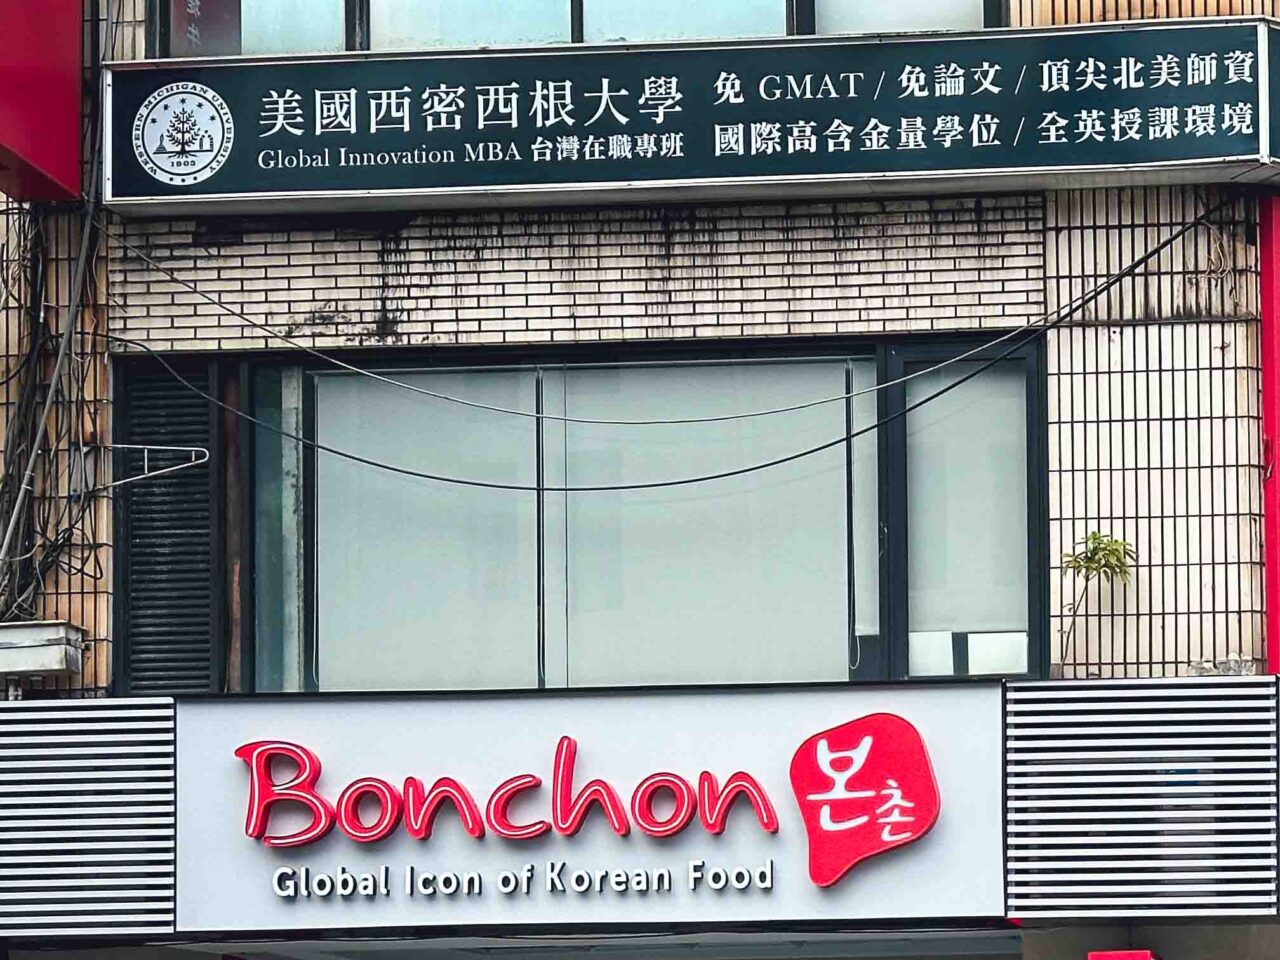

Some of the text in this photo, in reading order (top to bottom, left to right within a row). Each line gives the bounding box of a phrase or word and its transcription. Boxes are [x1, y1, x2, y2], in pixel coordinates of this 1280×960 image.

[144, 83, 208, 112] MICHIGAN
[712, 72, 745, 106] 免
[759, 71, 865, 101] GMAT
[897, 63, 1003, 99] 免論文
[1038, 49, 1255, 92] 頂尖北美師資
[258, 76, 684, 139] 美國西密西根大學
[714, 113, 1002, 158] 國際高含金量學位
[1038, 102, 1255, 145] 全英授課環境
[257, 135, 685, 170] Global Innovation MBA 台灣在職專班
[234, 735, 779, 847] Bonchon
[272, 857, 775, 898] Global Icon of Korean Food
